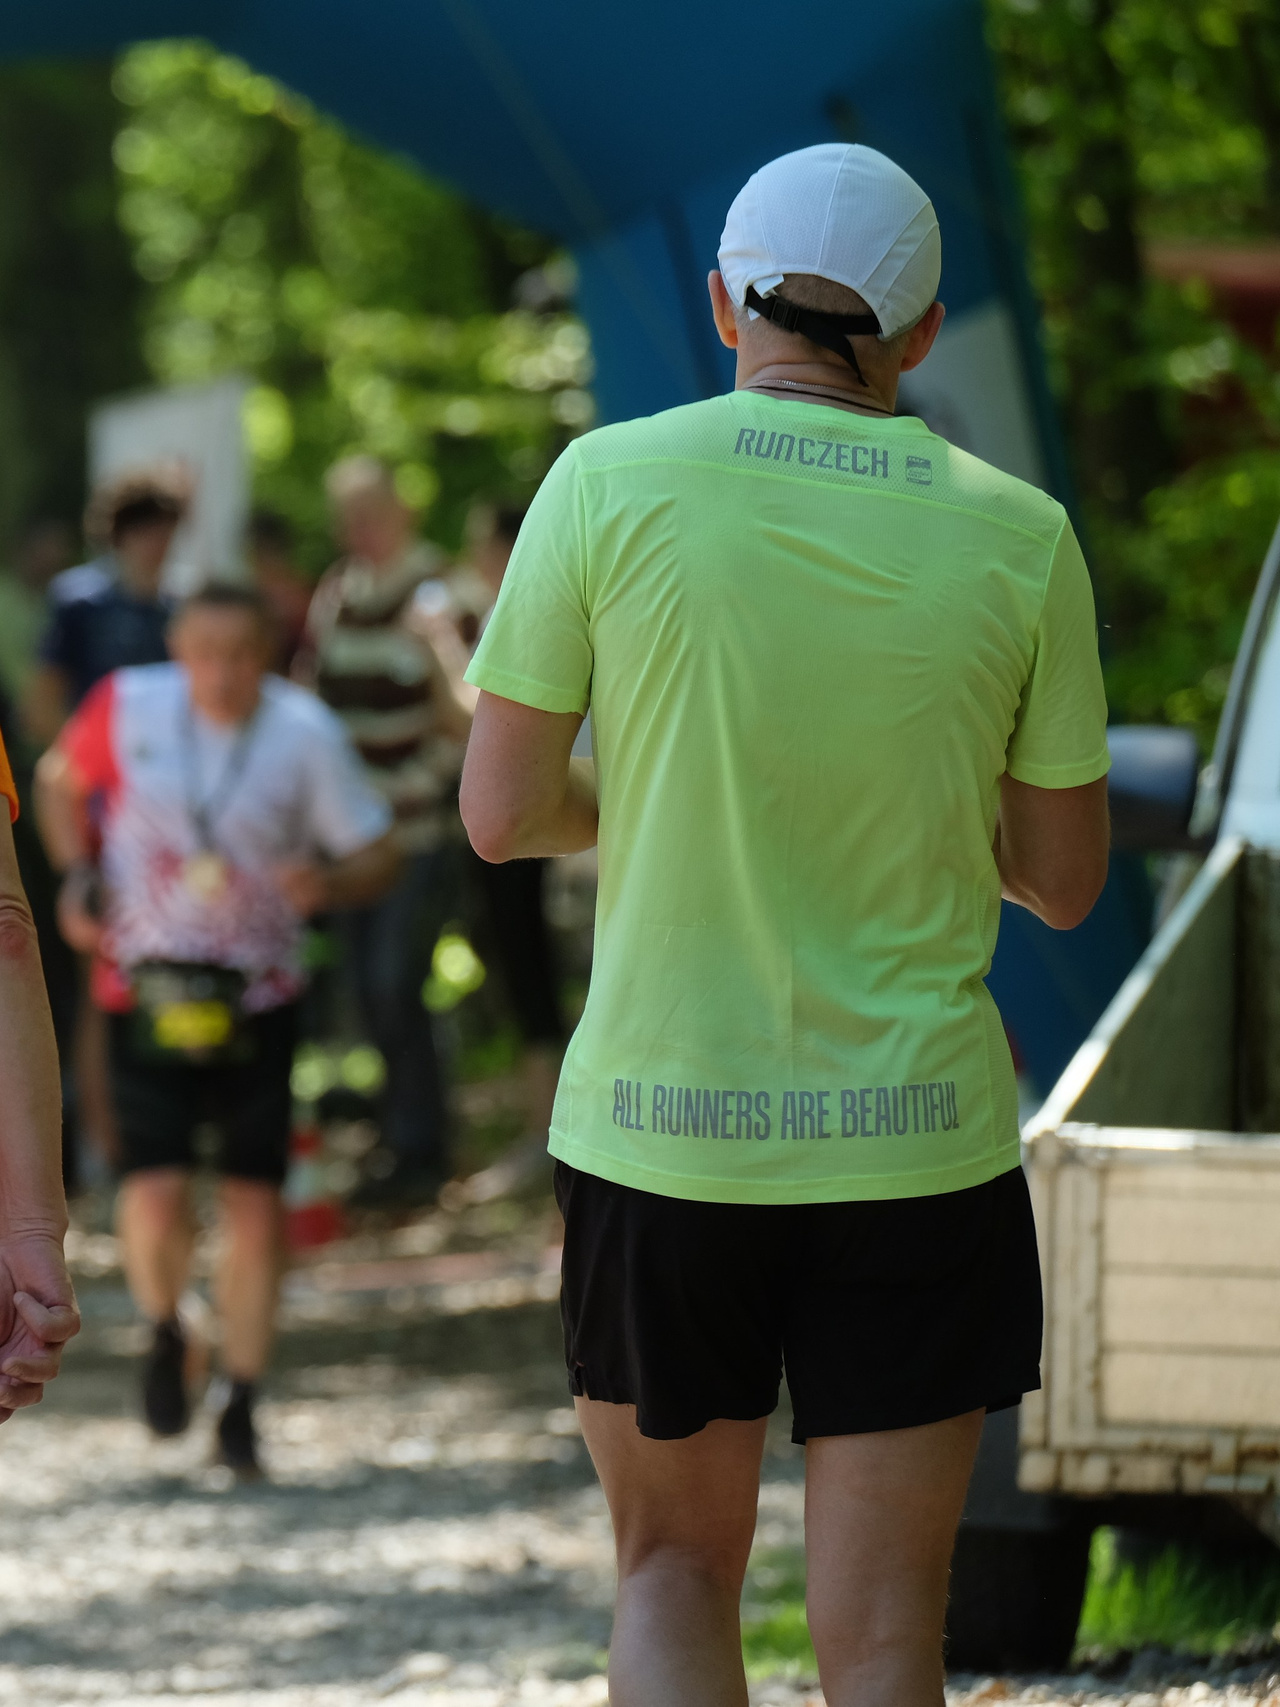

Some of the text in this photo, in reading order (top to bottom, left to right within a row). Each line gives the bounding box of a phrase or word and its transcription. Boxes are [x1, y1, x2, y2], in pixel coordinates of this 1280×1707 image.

[613, 1078, 960, 1141] ALL RUNNERS ARE BEAUTIFUL
